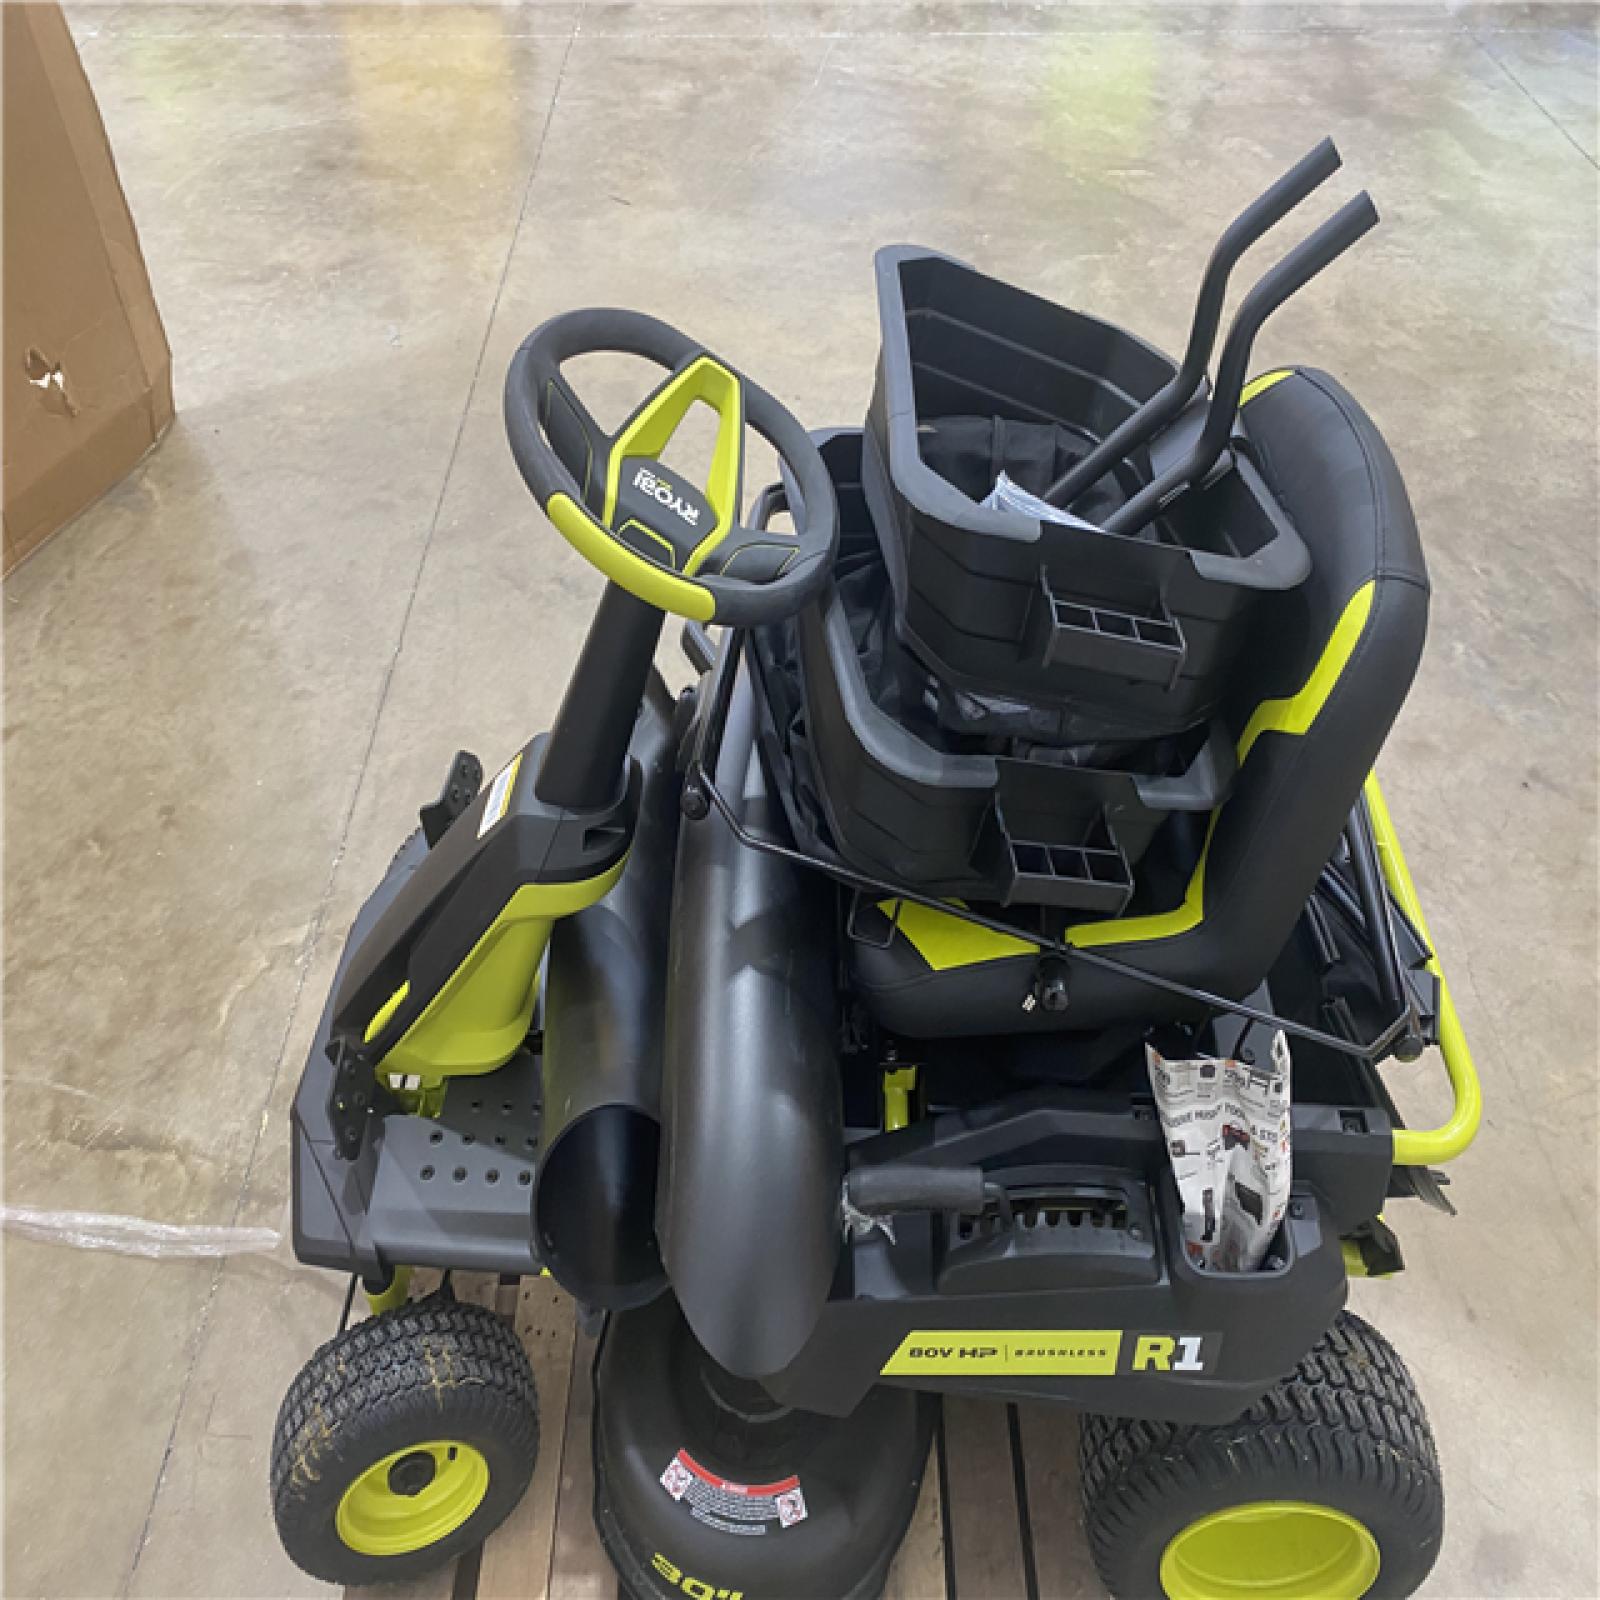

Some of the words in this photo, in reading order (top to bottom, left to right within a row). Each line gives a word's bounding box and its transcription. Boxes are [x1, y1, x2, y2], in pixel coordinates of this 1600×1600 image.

[632, 467, 699, 526] RYOBI
[959, 1346, 998, 1358] HP
[1131, 1335, 1204, 1371] R1
